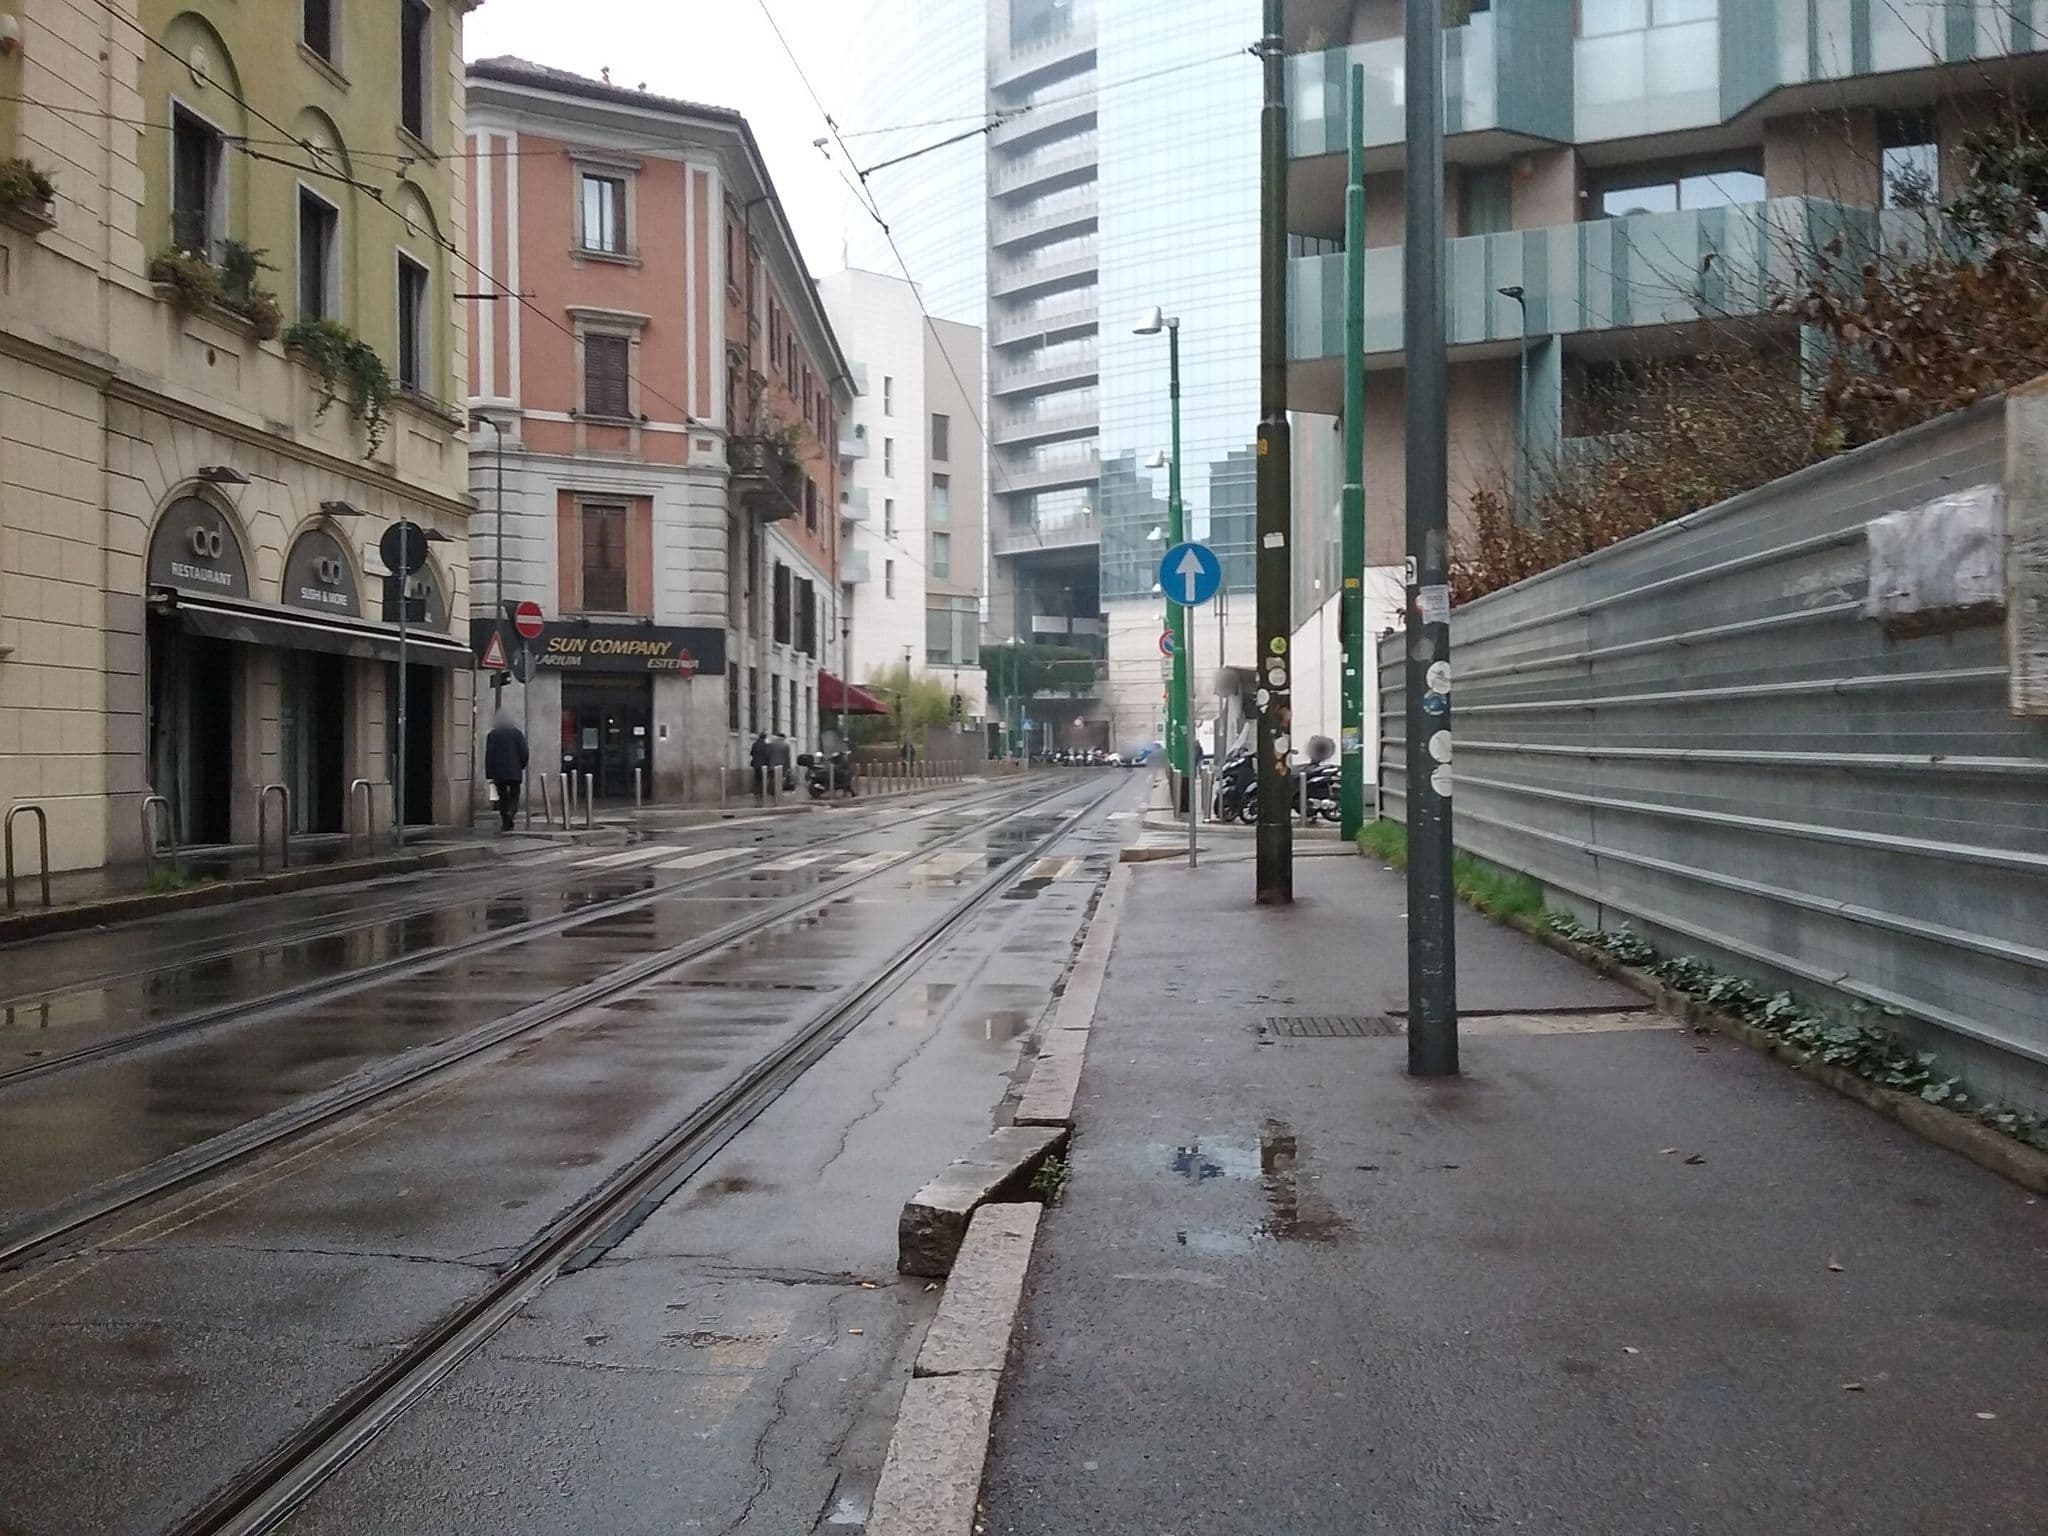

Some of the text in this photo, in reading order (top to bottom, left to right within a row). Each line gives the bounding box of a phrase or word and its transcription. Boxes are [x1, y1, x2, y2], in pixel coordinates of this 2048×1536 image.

[171, 562, 232, 586] RESTAURANT
[301, 587, 348, 606] SUSHI & MORE
[547, 637, 673, 656] SUN COMPANY
[534, 654, 582, 667] LARIUM
